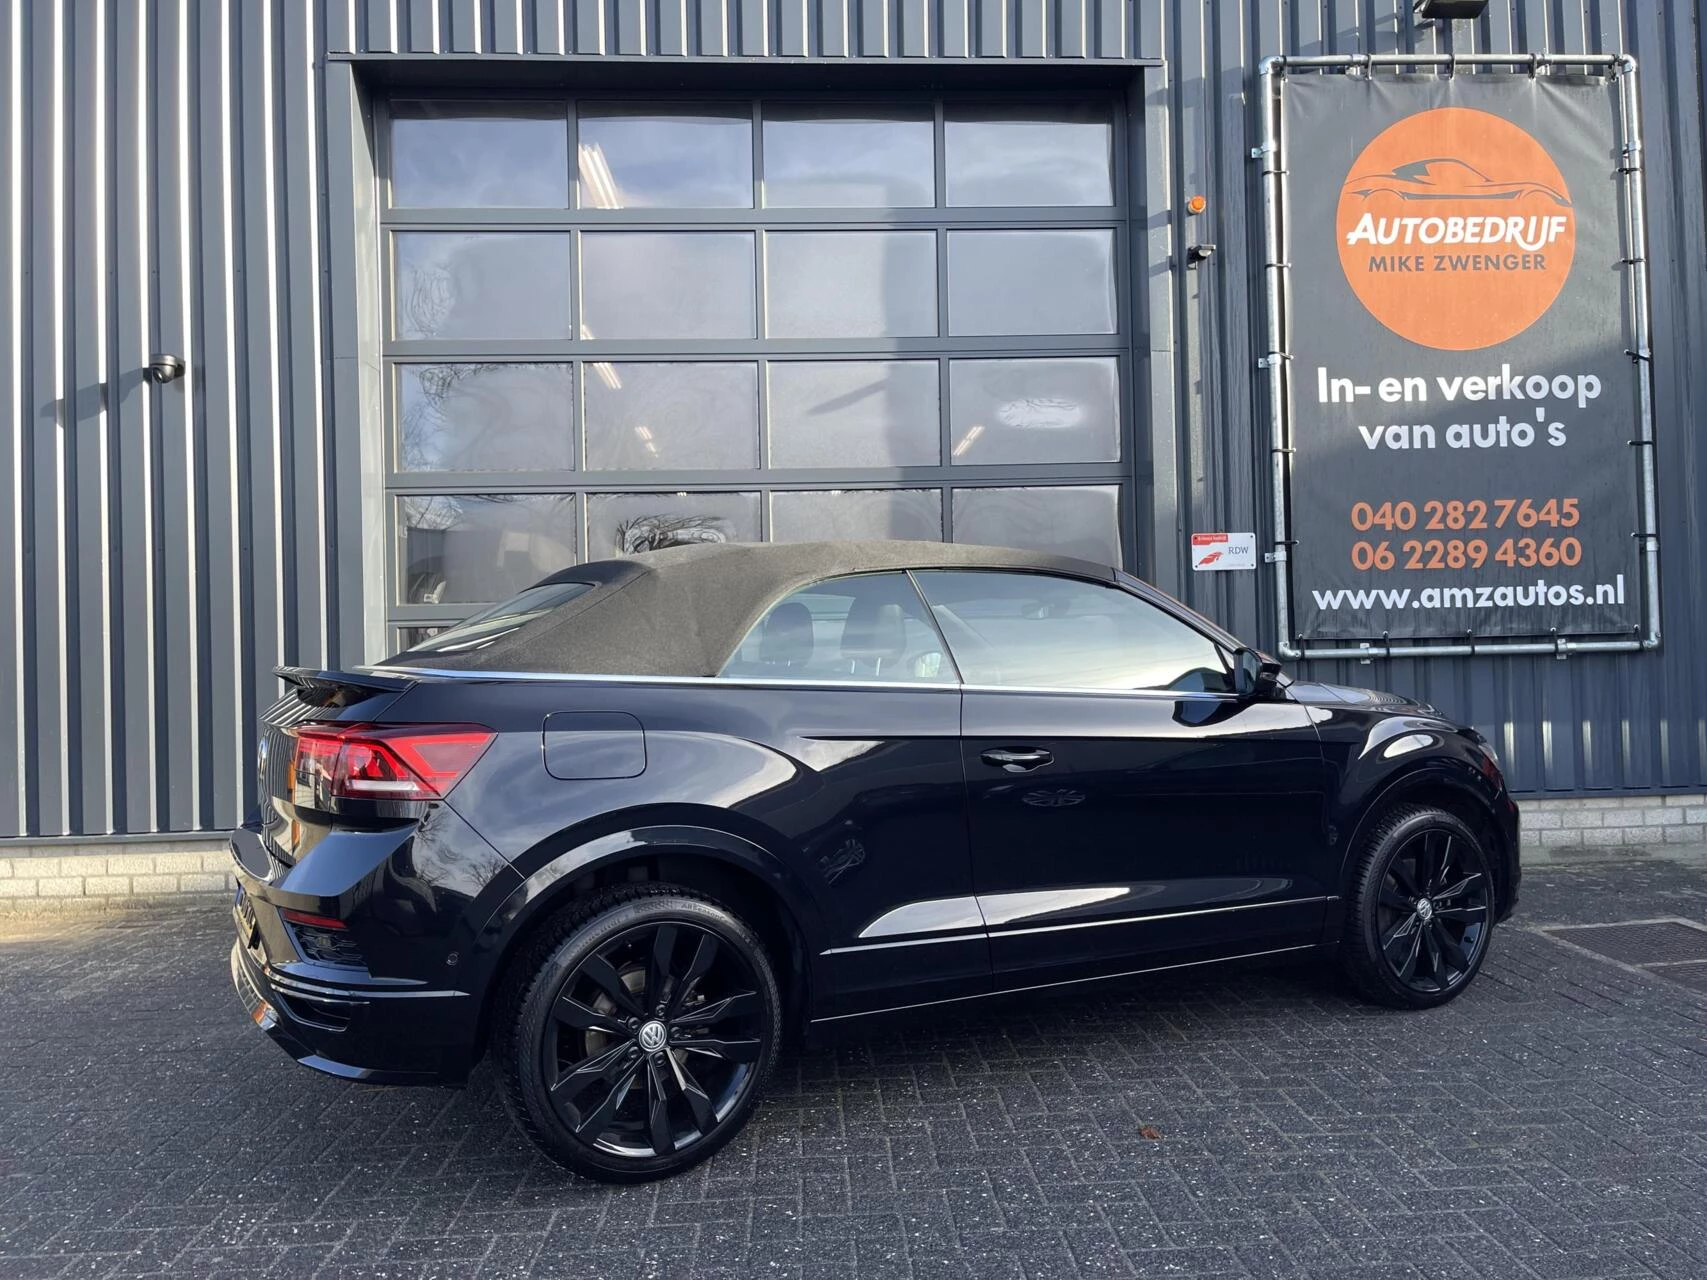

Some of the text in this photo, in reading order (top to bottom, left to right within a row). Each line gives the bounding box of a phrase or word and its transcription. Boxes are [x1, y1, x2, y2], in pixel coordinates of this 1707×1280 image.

[1368, 254, 1546, 273] MIKE ZWENGER
[1317, 363, 1602, 408] In- en verkoop
[1358, 407, 1567, 450] van auto's
[1350, 498, 1580, 532] 040 282 7645
[1351, 537, 1583, 571] 06 2289 4360
[1311, 574, 1625, 610] www.amzautos.nl
